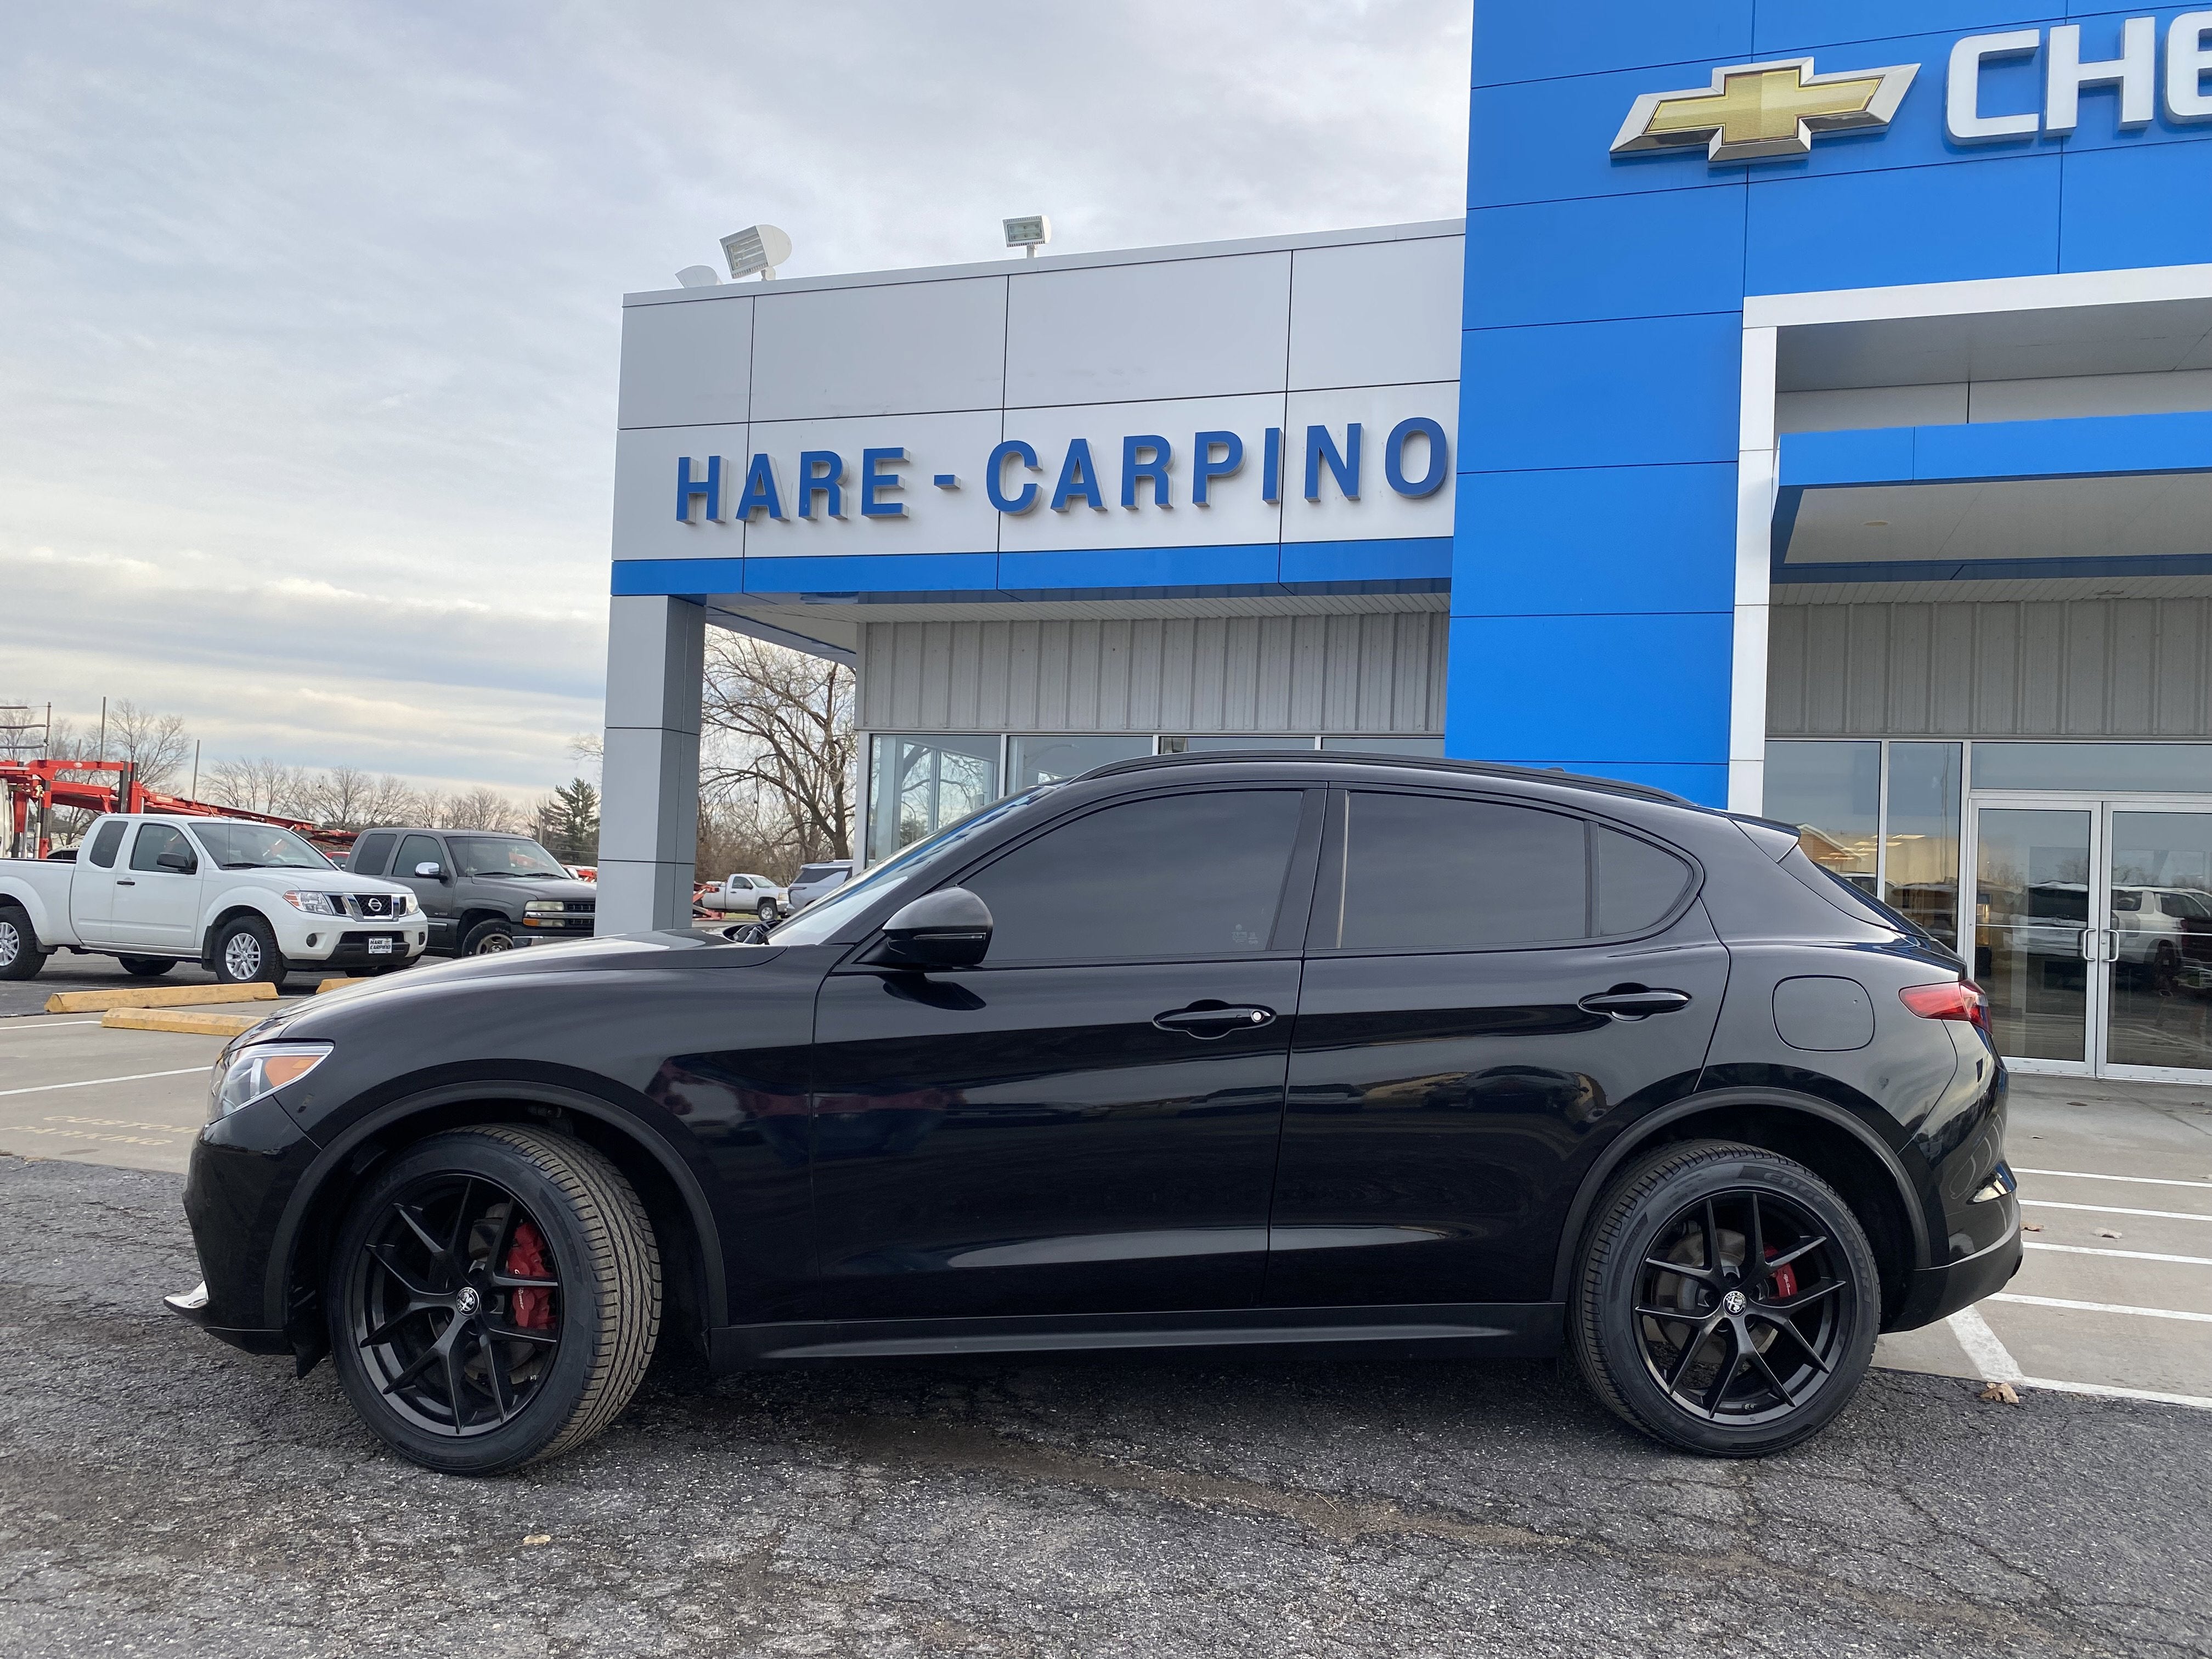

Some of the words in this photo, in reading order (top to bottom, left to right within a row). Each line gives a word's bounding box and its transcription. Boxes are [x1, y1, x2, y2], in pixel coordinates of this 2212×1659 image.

[676, 447, 910, 523] HARE
[986, 417, 1449, 515] CARPINO
[1764, 1172, 1830, 1210] EDGE
[1837, 1218, 1871, 1303] SPORT
